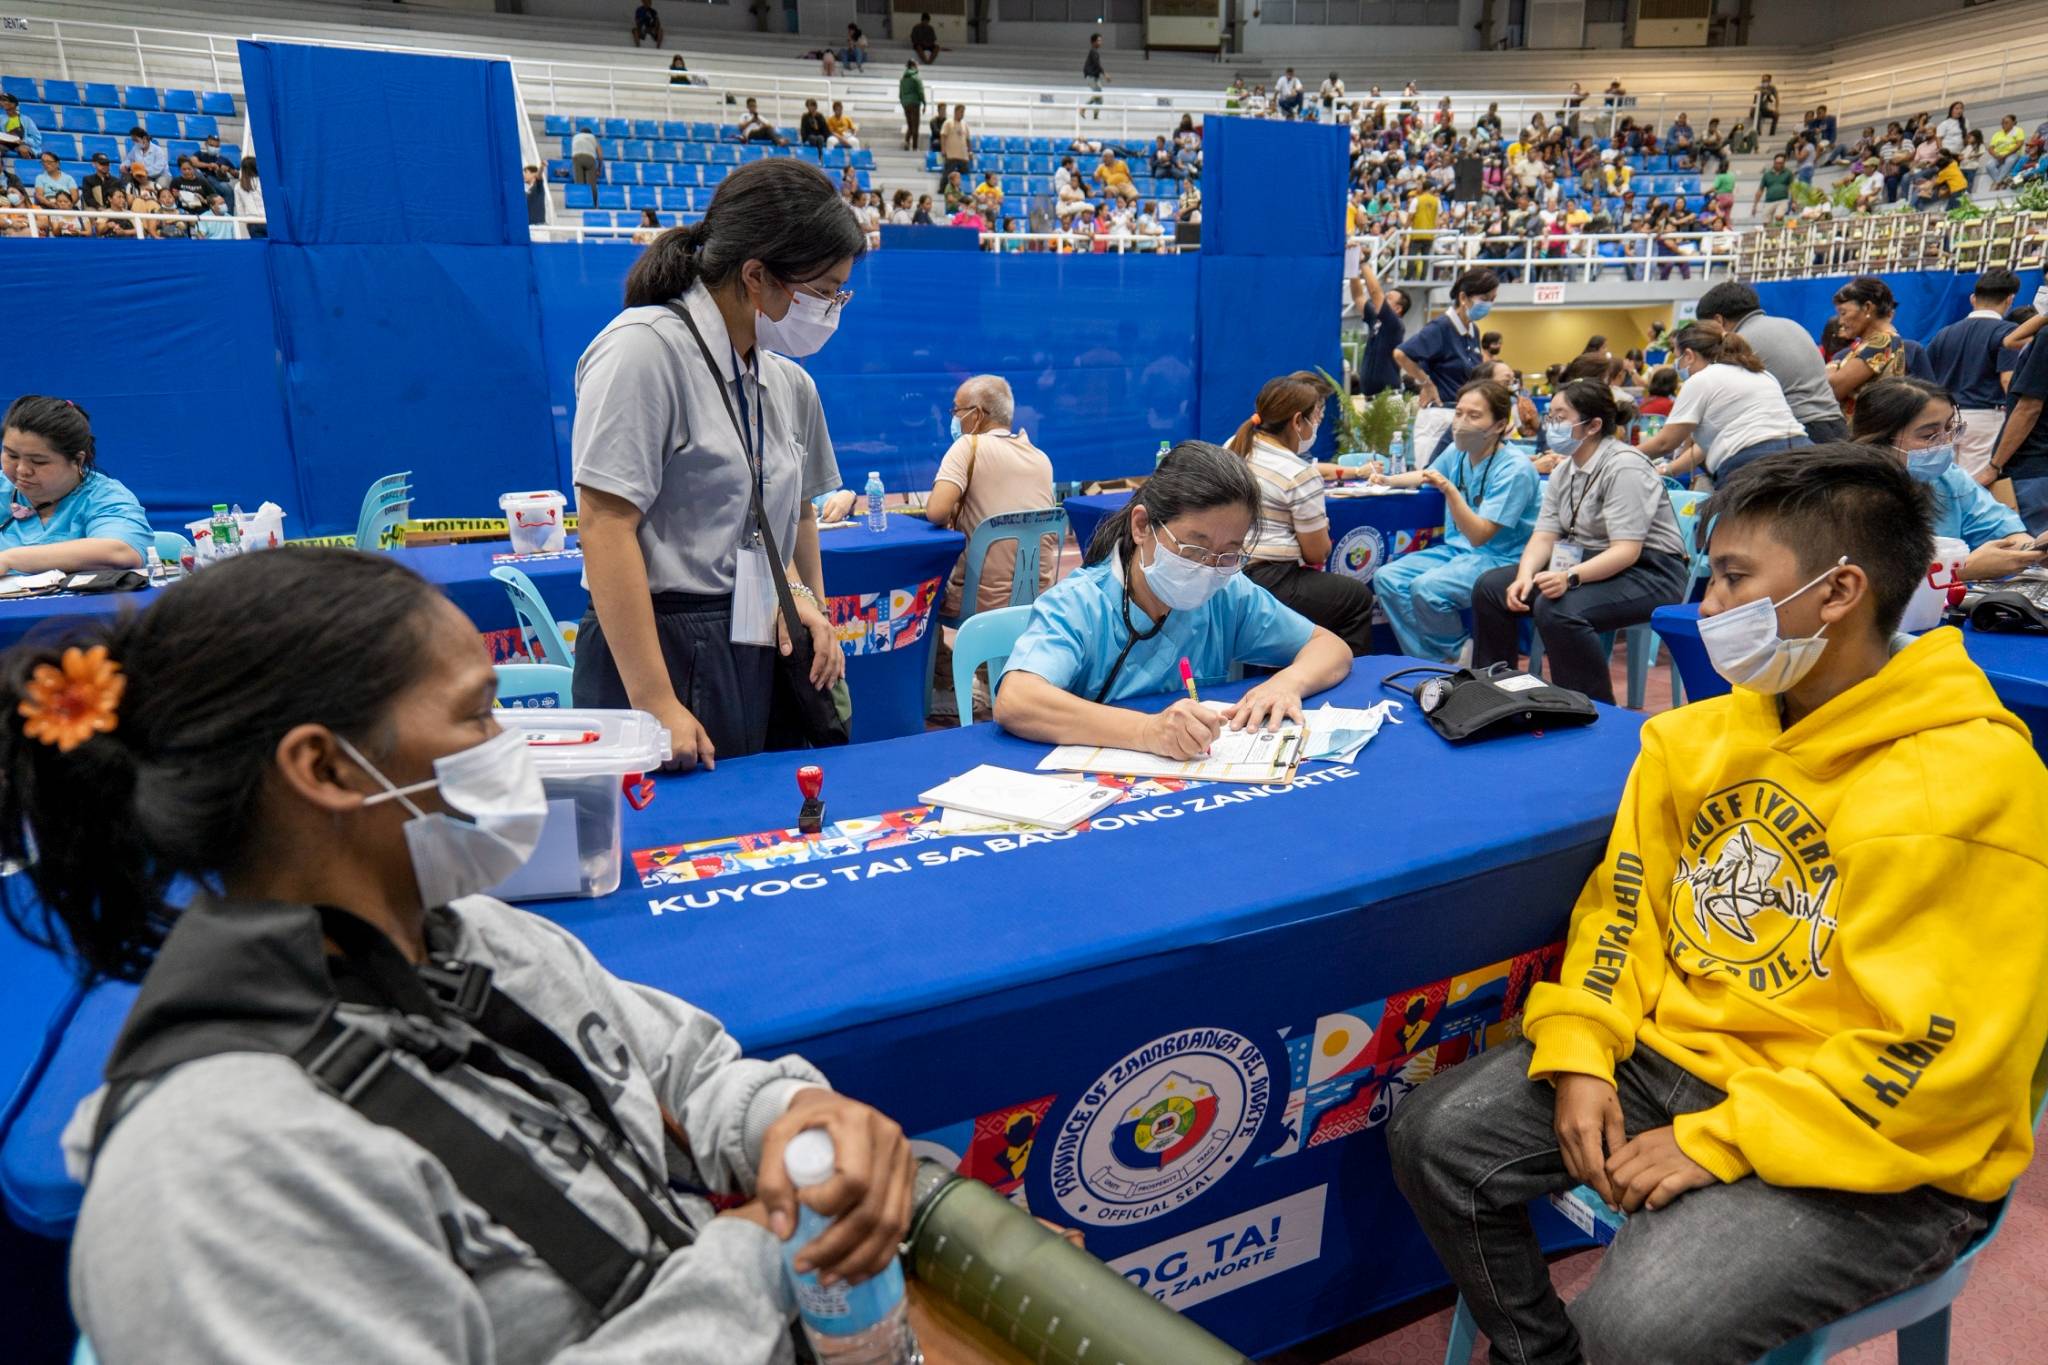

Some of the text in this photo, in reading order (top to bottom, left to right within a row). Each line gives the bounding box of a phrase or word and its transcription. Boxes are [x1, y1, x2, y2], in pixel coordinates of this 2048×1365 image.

[1537, 291, 1560, 301] EXIT
[647, 872, 829, 916] KUYOG
[831, 856, 913, 883] TA!
[917, 845, 985, 869] SA
[1182, 765, 1360, 813] ZANORTE
[1053, 1029, 1269, 1198] PROVINCE OF ZAMBOANGA DEL NORTE
[1138, 1175, 1177, 1192] PROSPERITY
[1196, 1145, 1216, 1163] PEACE
[1097, 1175, 1214, 1220] OFFICIAL SEAL
[1122, 1216, 1282, 1289] OG TA!
[1171, 1246, 1278, 1297] ZANORTE
